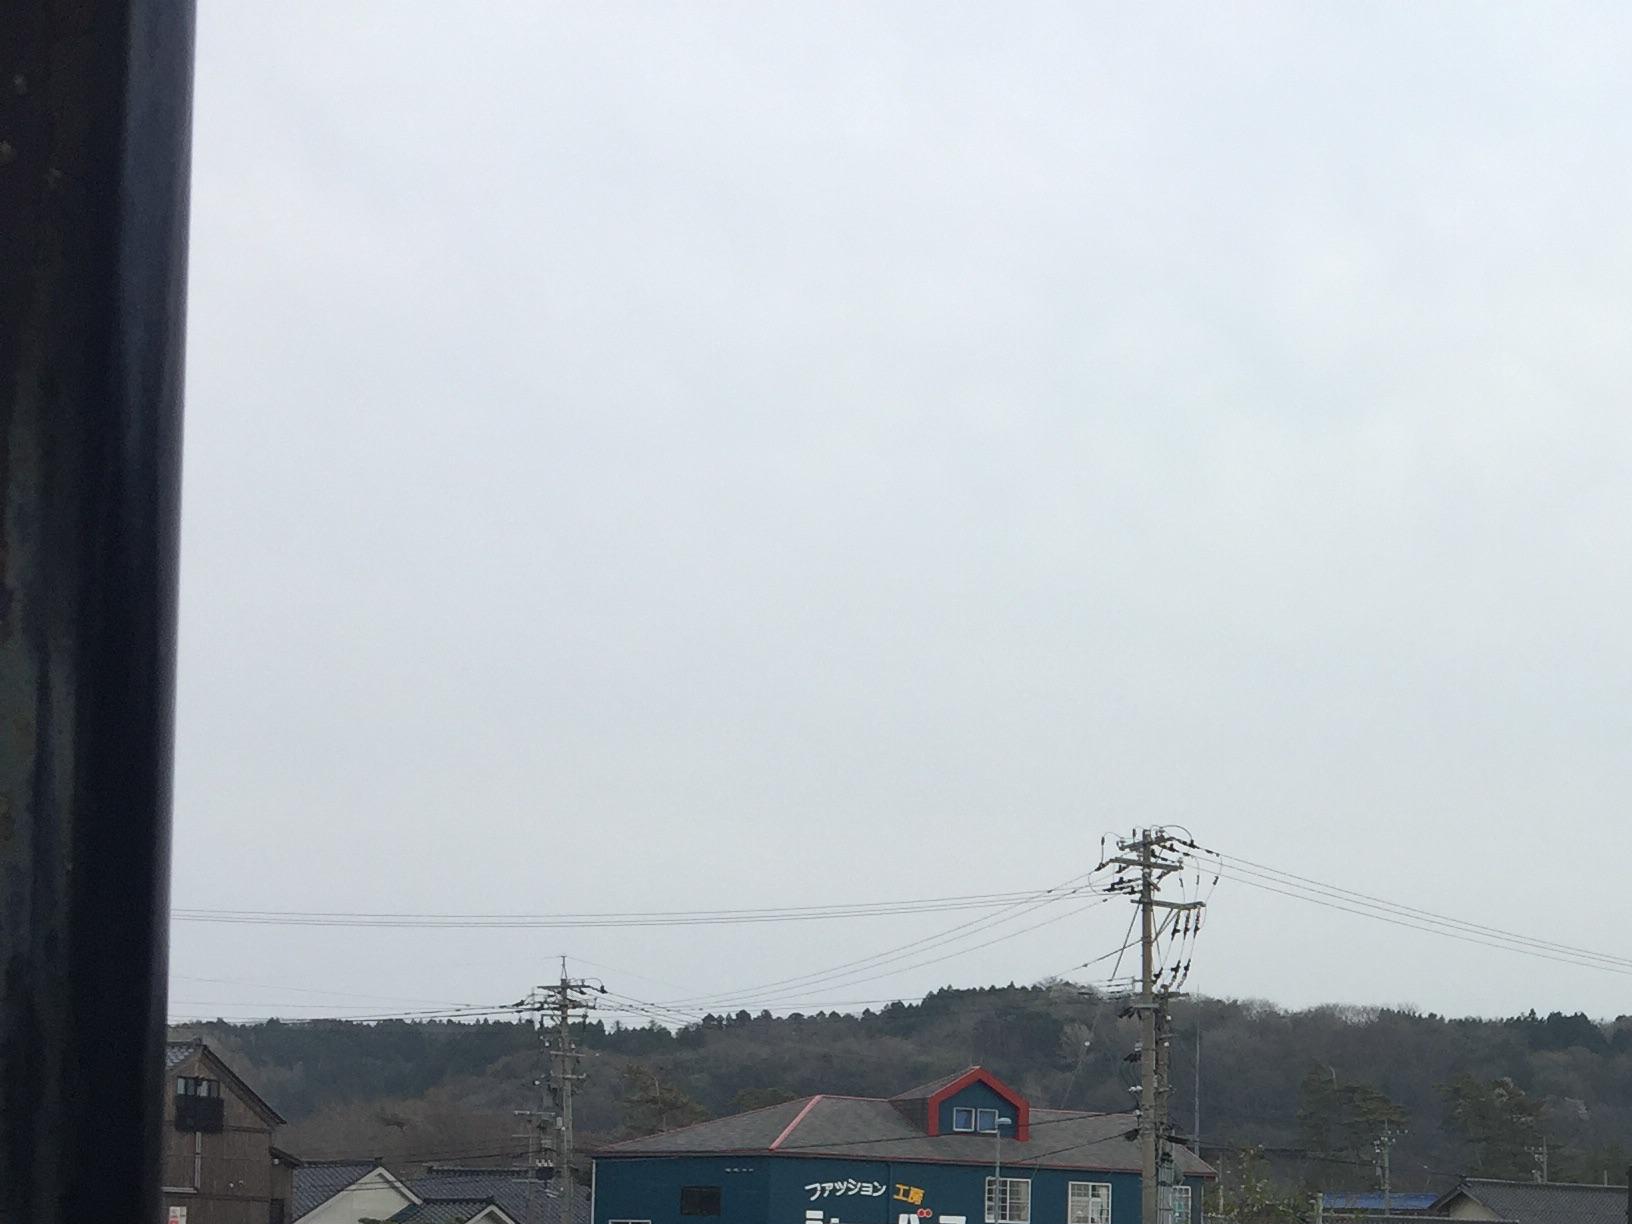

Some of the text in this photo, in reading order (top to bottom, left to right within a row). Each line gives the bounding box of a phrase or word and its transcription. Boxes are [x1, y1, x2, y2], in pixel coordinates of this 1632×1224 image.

[804, 1178, 887, 1201] ファッション
